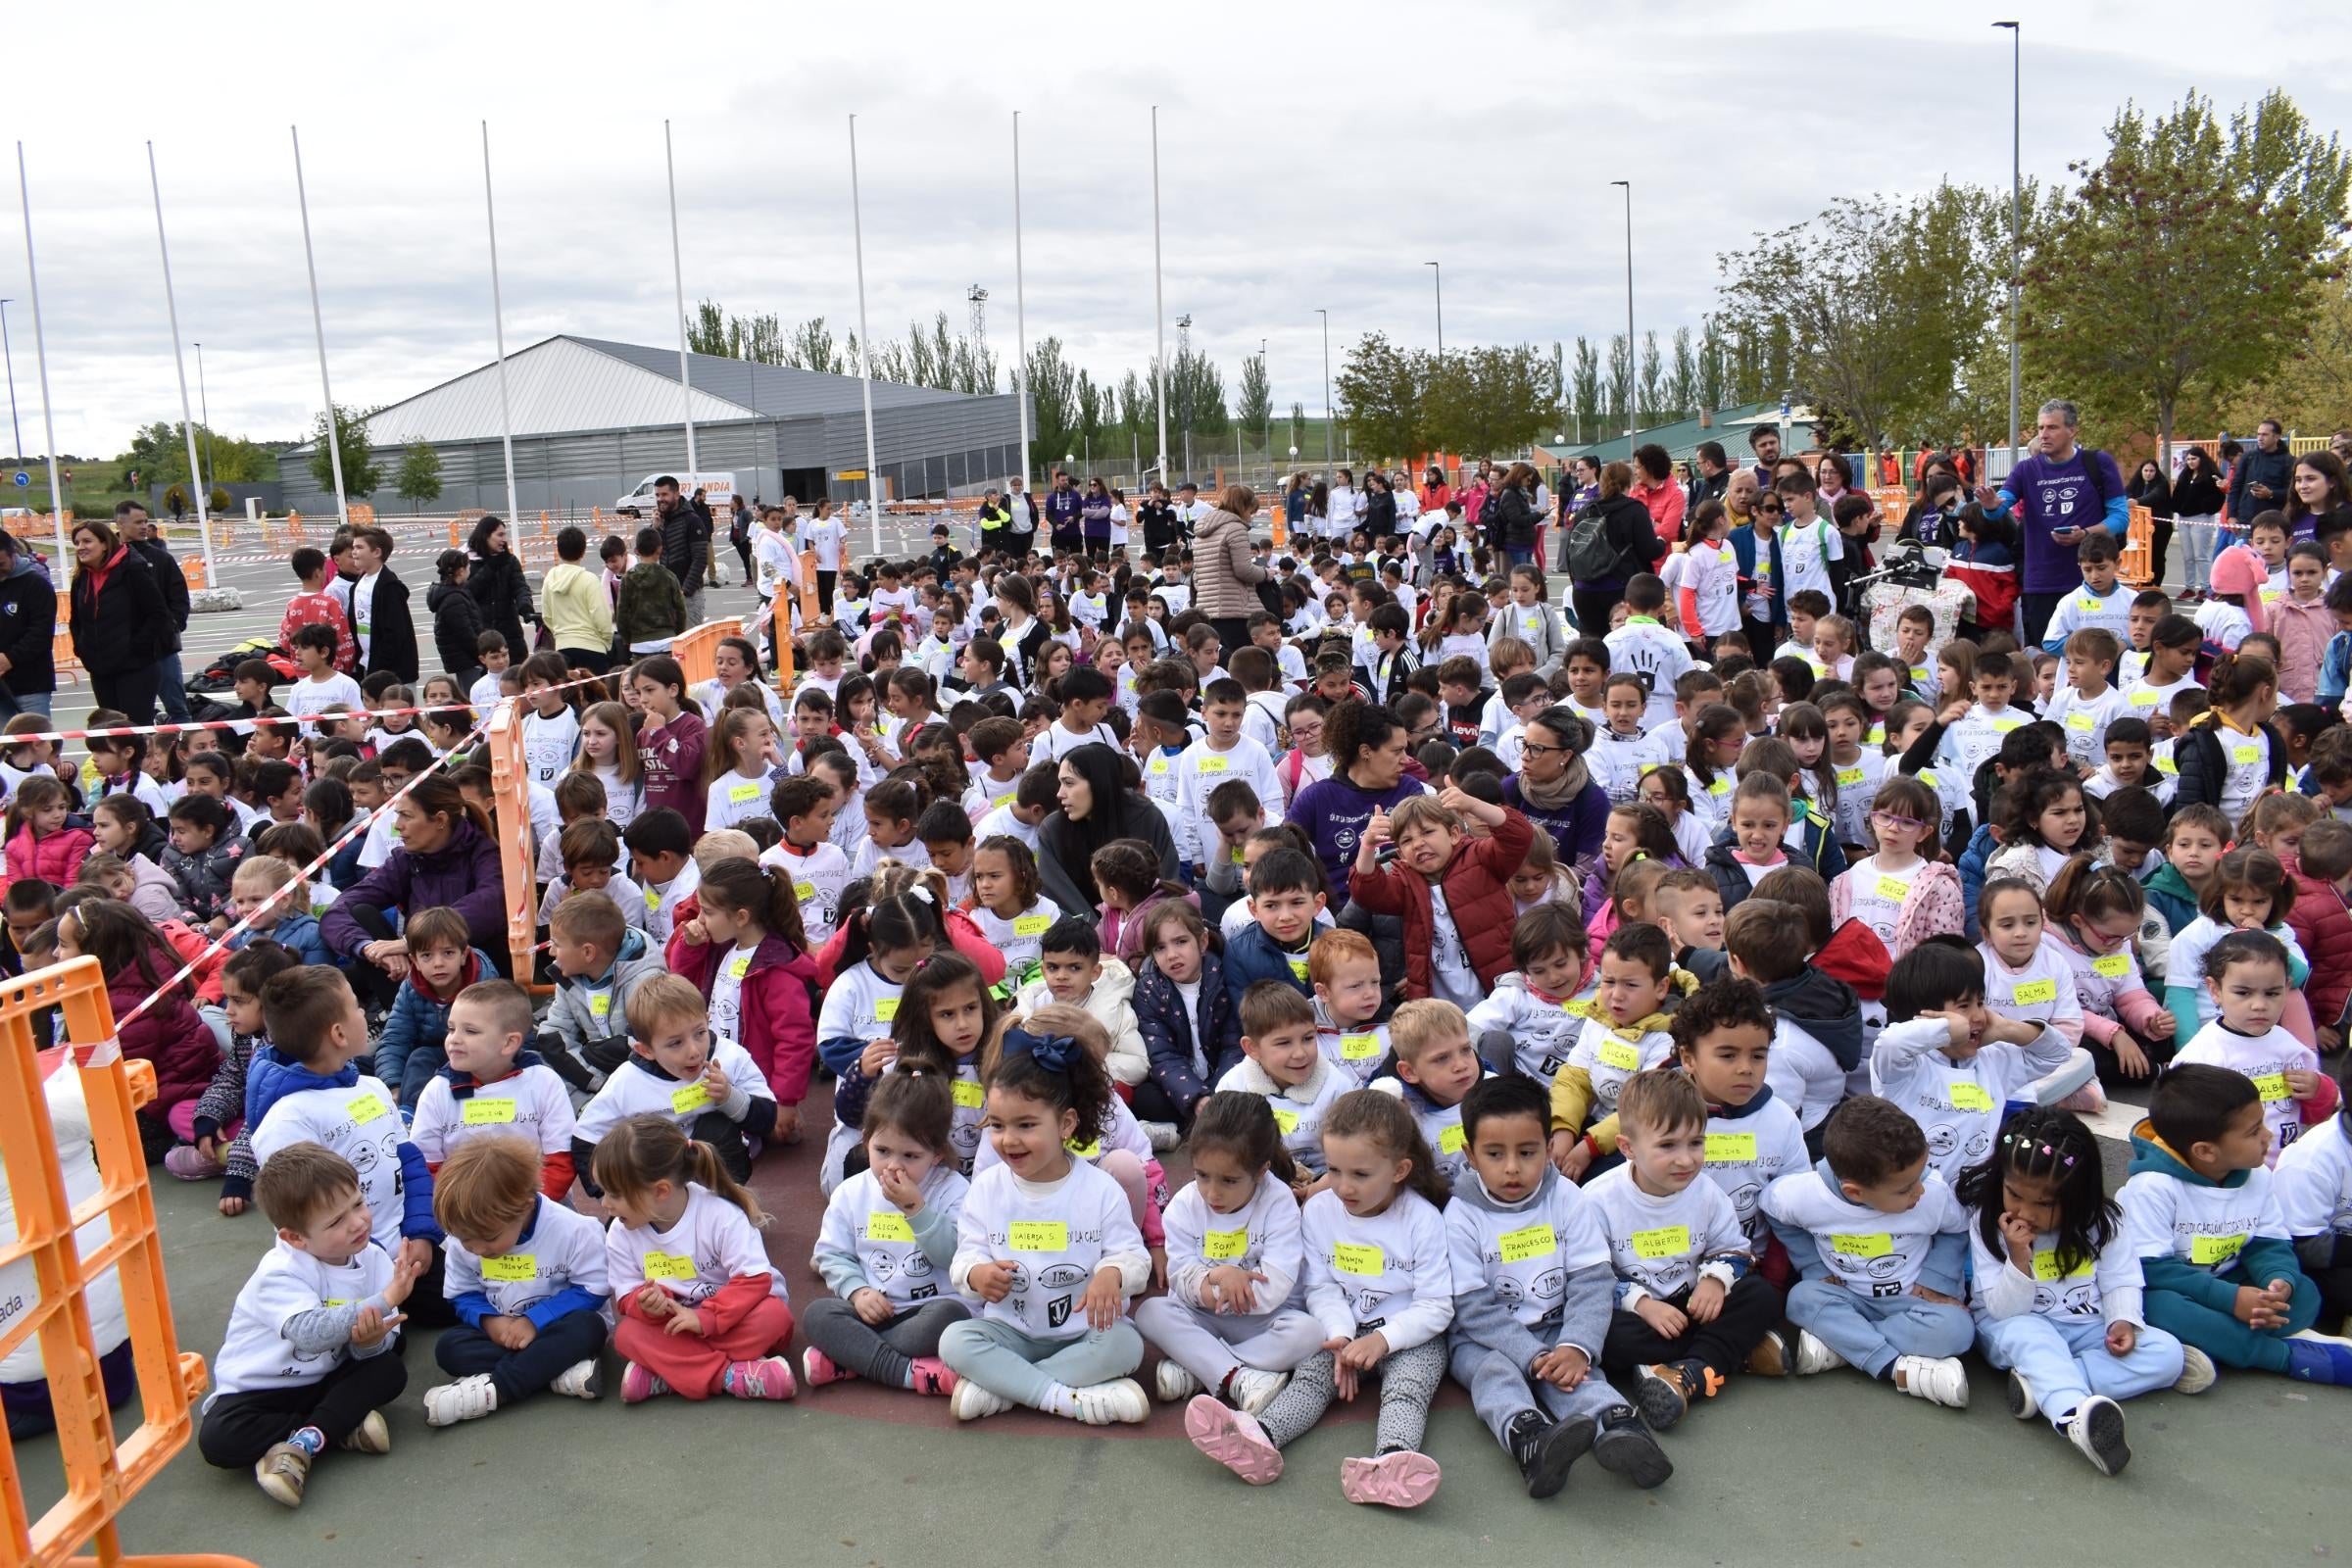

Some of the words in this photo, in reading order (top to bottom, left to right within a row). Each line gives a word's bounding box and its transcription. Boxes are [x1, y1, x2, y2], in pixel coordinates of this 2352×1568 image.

[2017, 987, 2047, 1001] SALMA
[872, 1222, 900, 1232] ALICIA
[1505, 1236, 1551, 1252] FRANCESCO
[1642, 1235, 1681, 1248] ALBERTO
[1841, 1241, 1869, 1250] ADAM
[2210, 1242, 2237, 1254] LUKA
[499, 1262, 530, 1271] DANIEL
